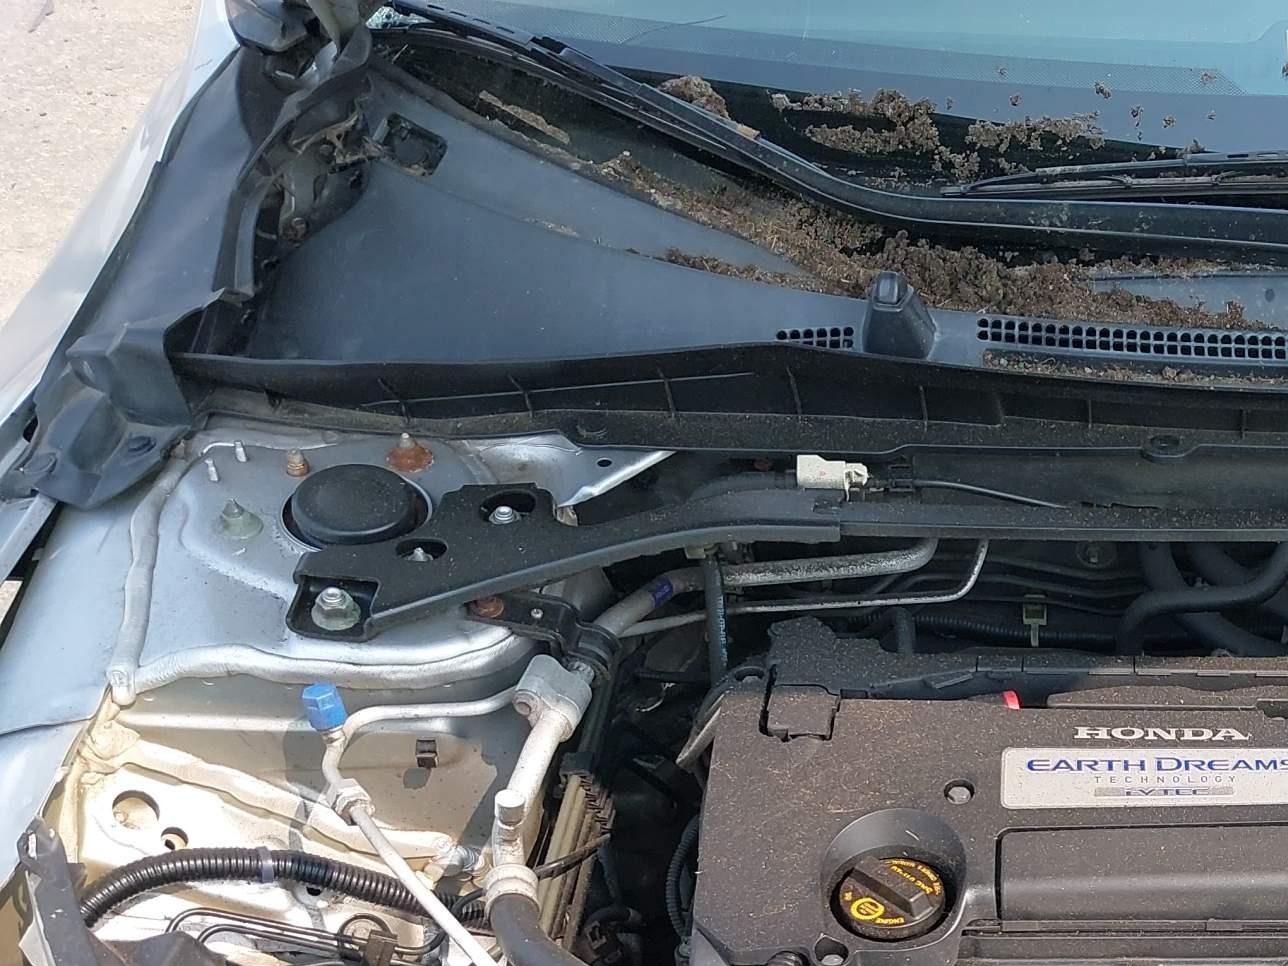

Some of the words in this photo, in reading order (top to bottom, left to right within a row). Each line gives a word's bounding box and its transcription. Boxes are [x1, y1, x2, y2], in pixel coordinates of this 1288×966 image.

[1074, 727, 1249, 741] HONDA
[1026, 758, 1146, 772] EARTH
[1094, 775, 1237, 784] TECHNOLOGY
